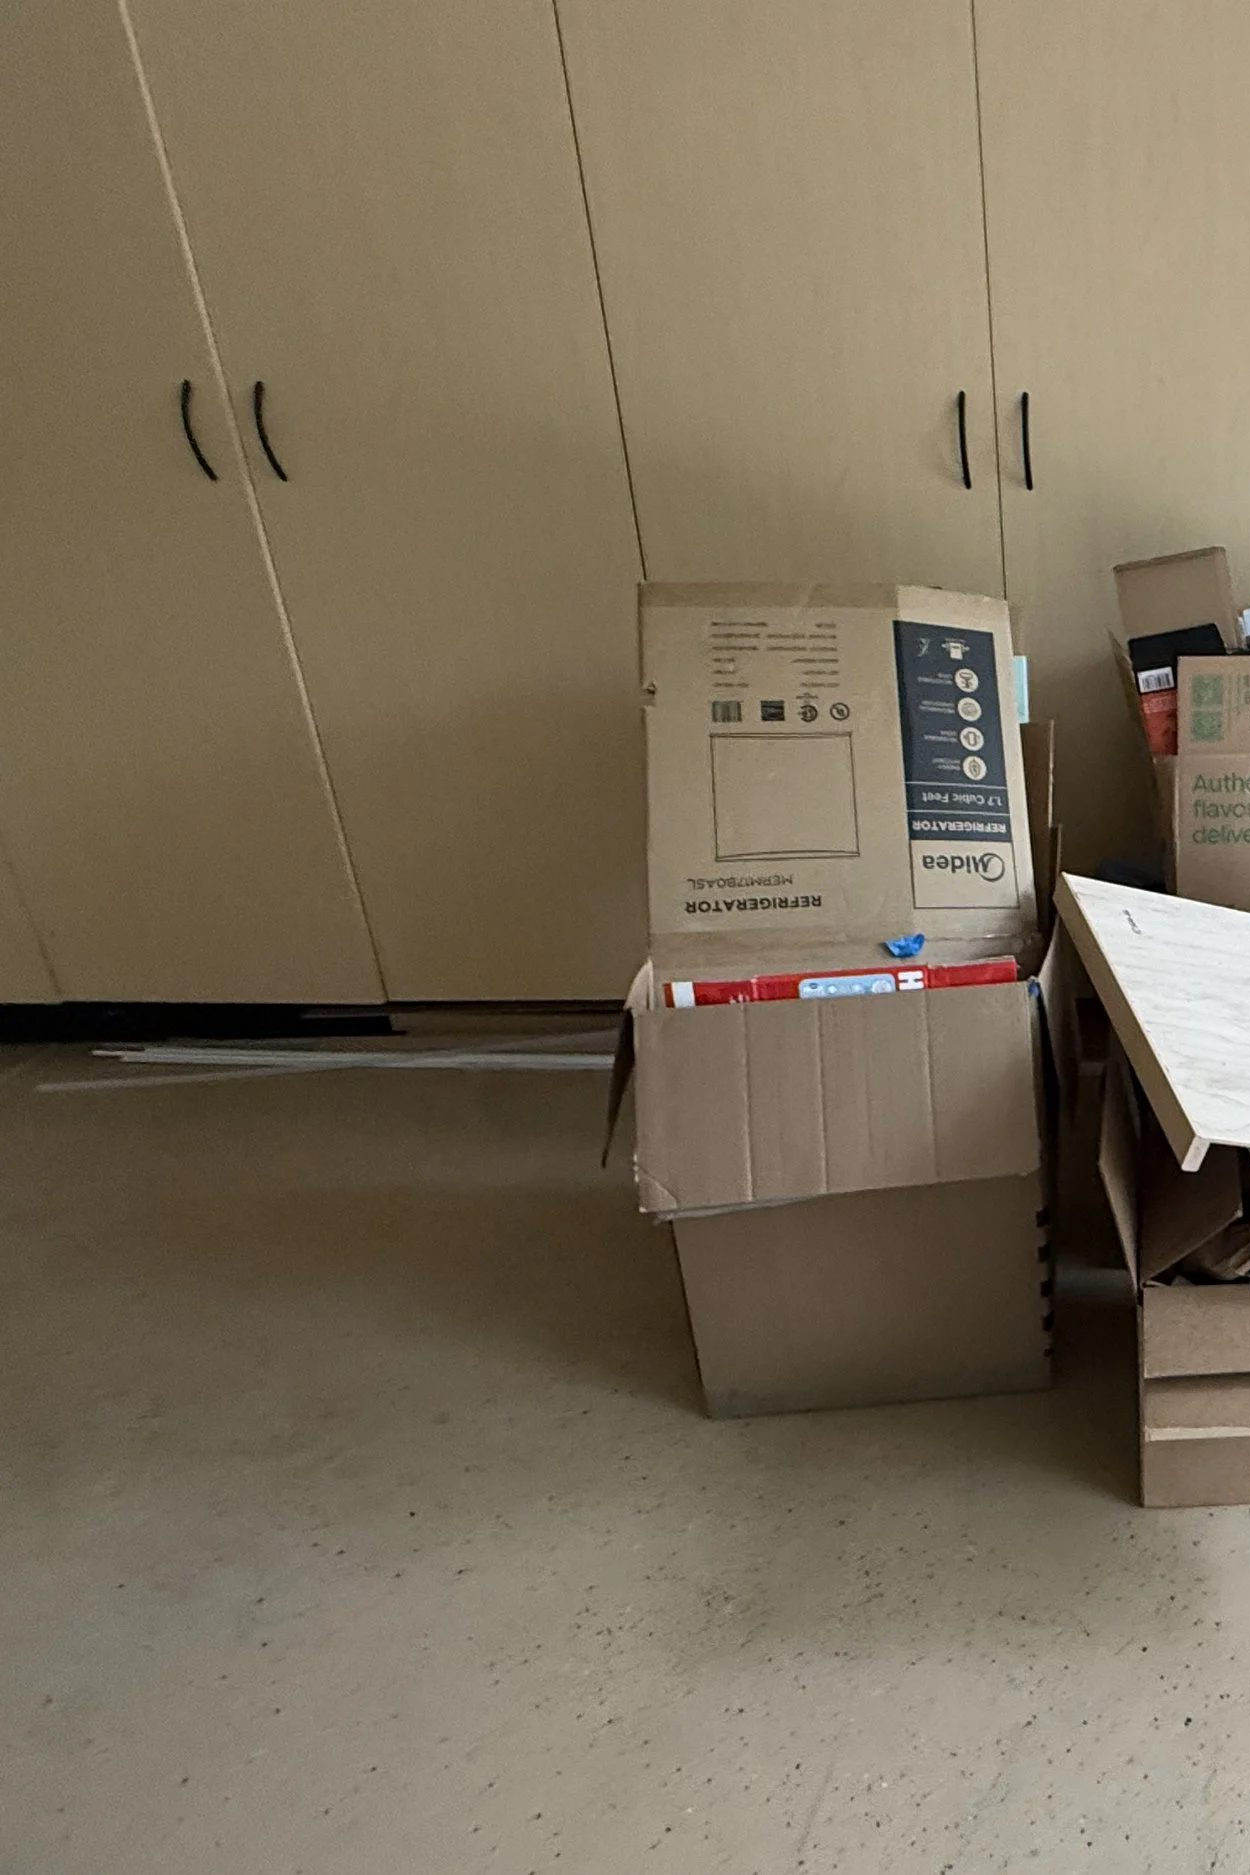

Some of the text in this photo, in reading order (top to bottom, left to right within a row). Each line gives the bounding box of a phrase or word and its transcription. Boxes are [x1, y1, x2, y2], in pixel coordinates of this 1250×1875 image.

[922, 792, 1003, 806] 1.7 Cubic Feet
[912, 820, 1007, 833] REFRIGERATOR
[922, 852, 1005, 882] Midea
[684, 895, 823, 914] REFRIGERATOR
